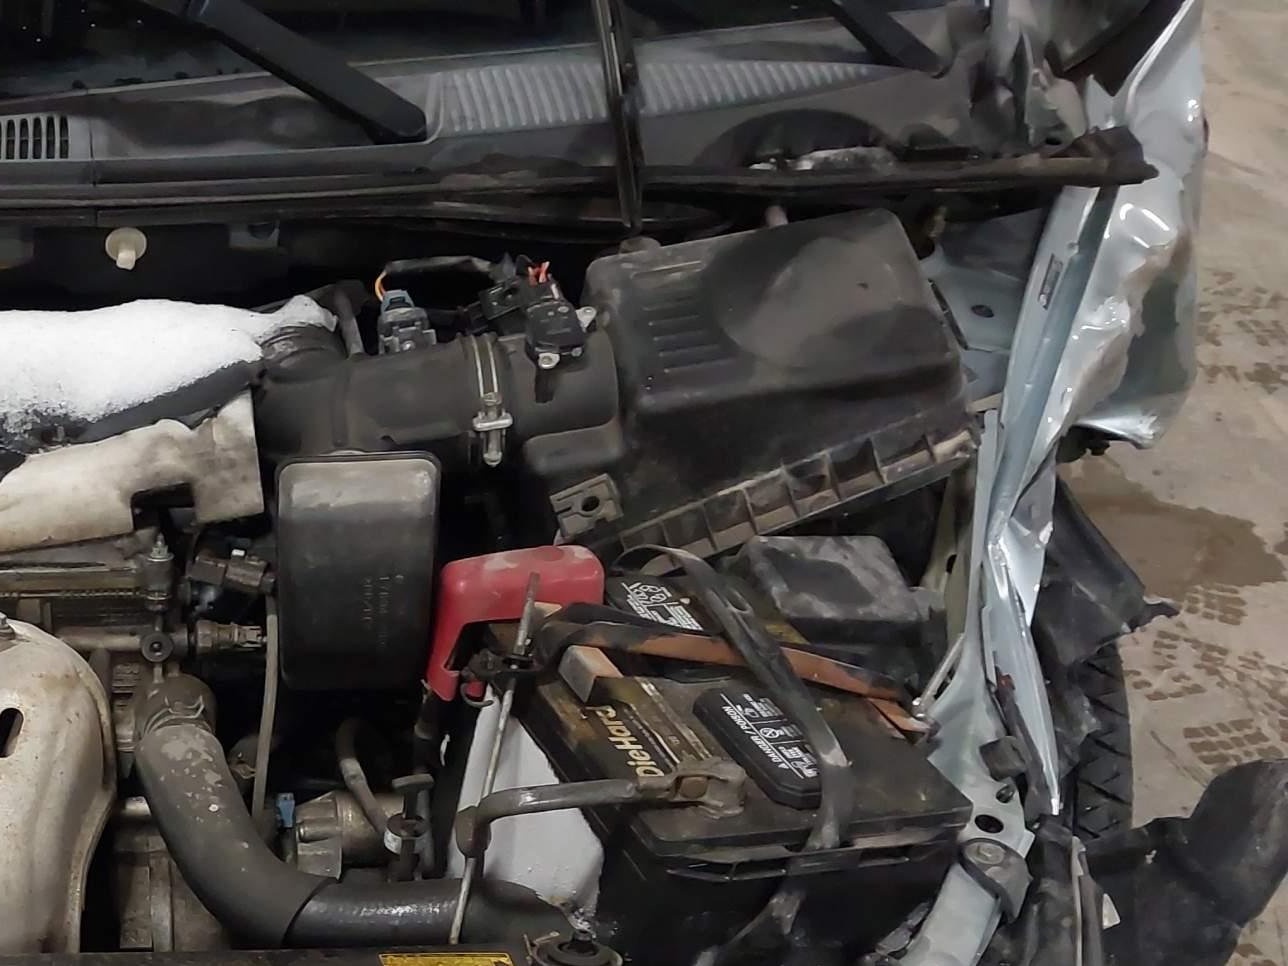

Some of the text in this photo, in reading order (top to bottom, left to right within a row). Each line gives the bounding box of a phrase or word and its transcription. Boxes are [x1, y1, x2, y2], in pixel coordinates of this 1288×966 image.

[721, 704, 751, 732] POISON
[586, 703, 665, 778] DieHard
[750, 730, 783, 764] DANGER
